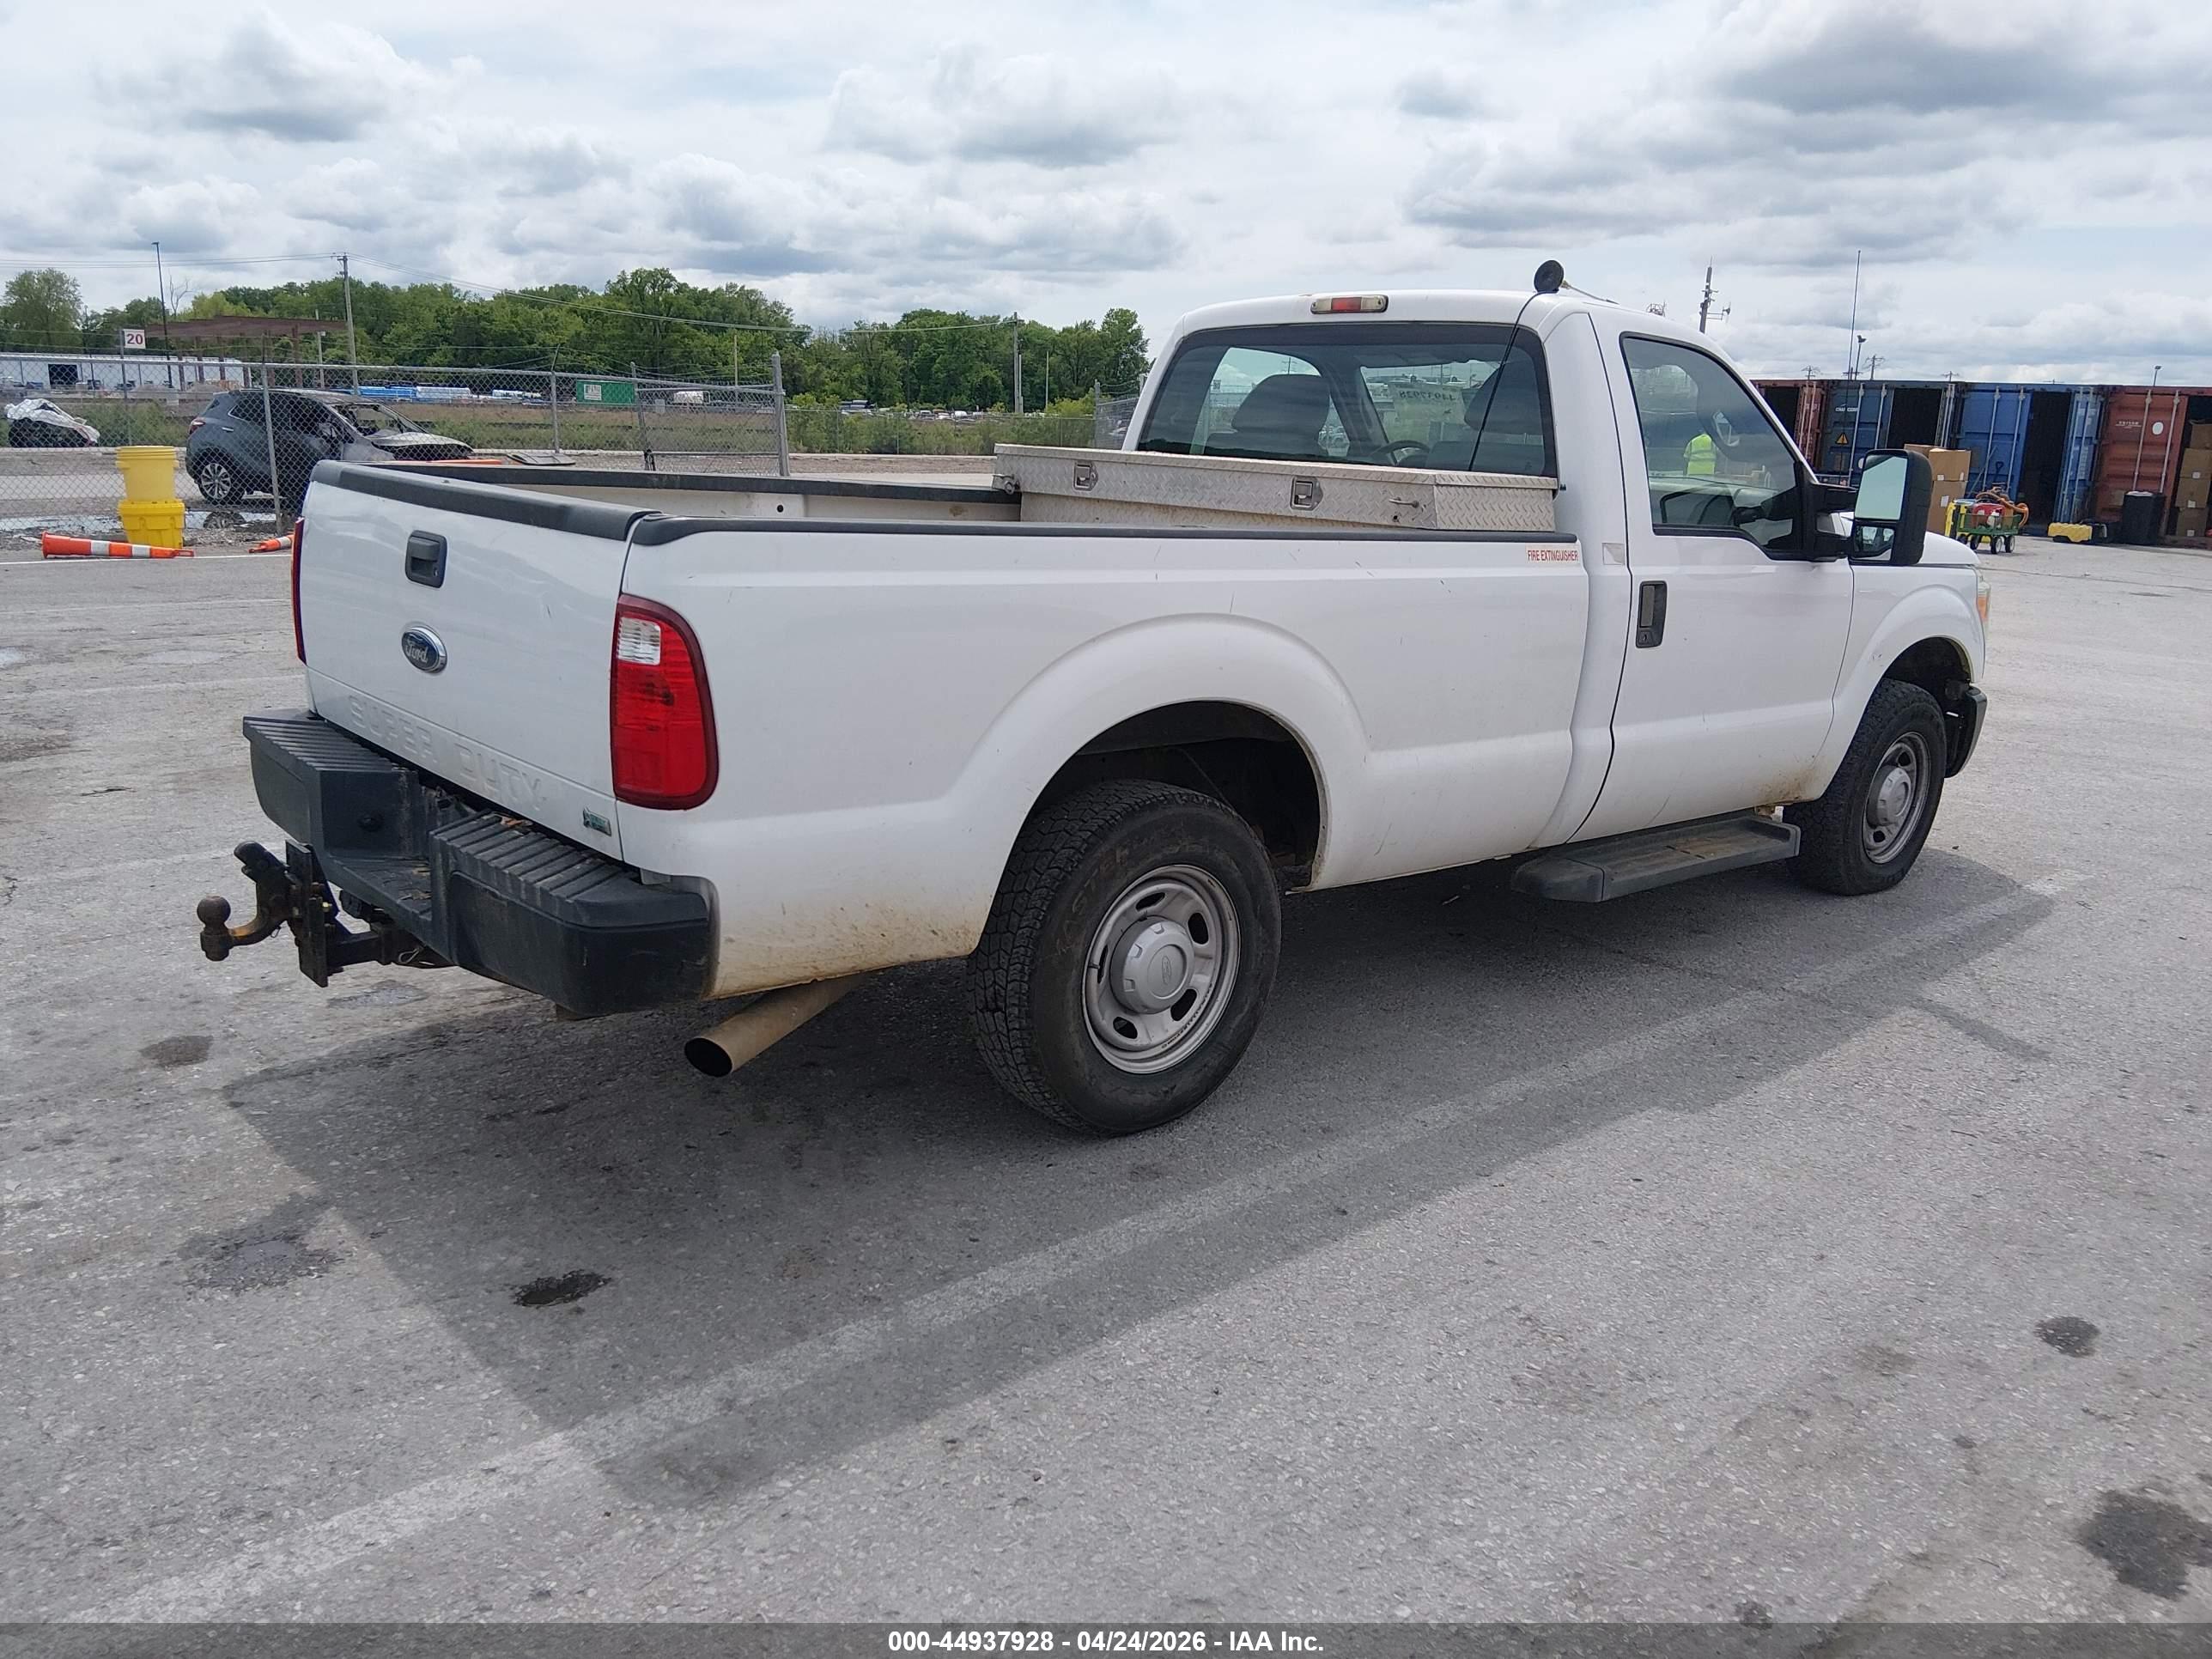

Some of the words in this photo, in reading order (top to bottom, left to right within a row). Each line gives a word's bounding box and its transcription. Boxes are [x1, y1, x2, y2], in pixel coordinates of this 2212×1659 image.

[126, 333, 143, 344] 20
[1528, 550, 1540, 562] FIRE
[1540, 550, 1578, 562] EXTINGUISHER
[405, 637, 429, 664] Ford
[348, 694, 439, 763] SUPER
[455, 742, 547, 811] DUTY
